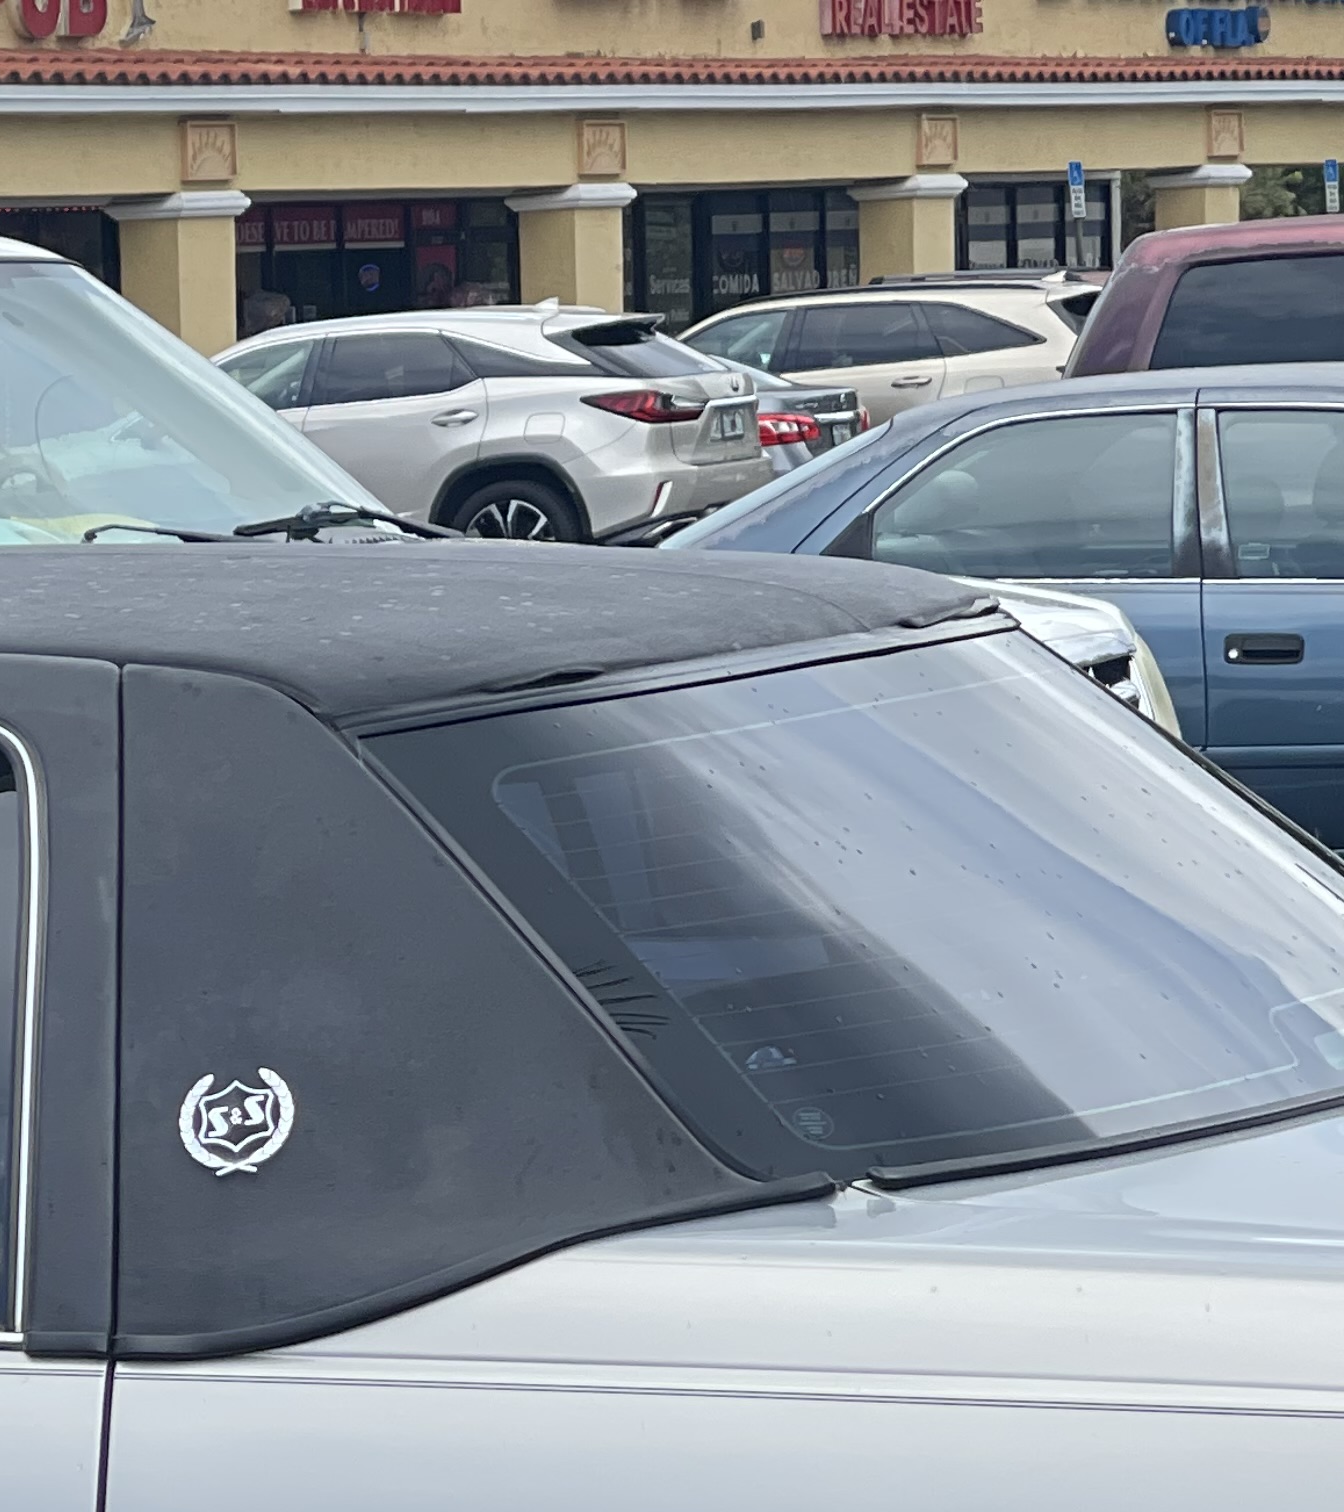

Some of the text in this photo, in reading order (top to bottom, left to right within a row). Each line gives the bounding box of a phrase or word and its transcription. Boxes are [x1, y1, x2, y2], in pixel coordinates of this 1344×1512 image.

[237, 219, 289, 243] DESEVE
[329, 217, 399, 241] PMPERED!
[208, 1094, 265, 1138] S&S
